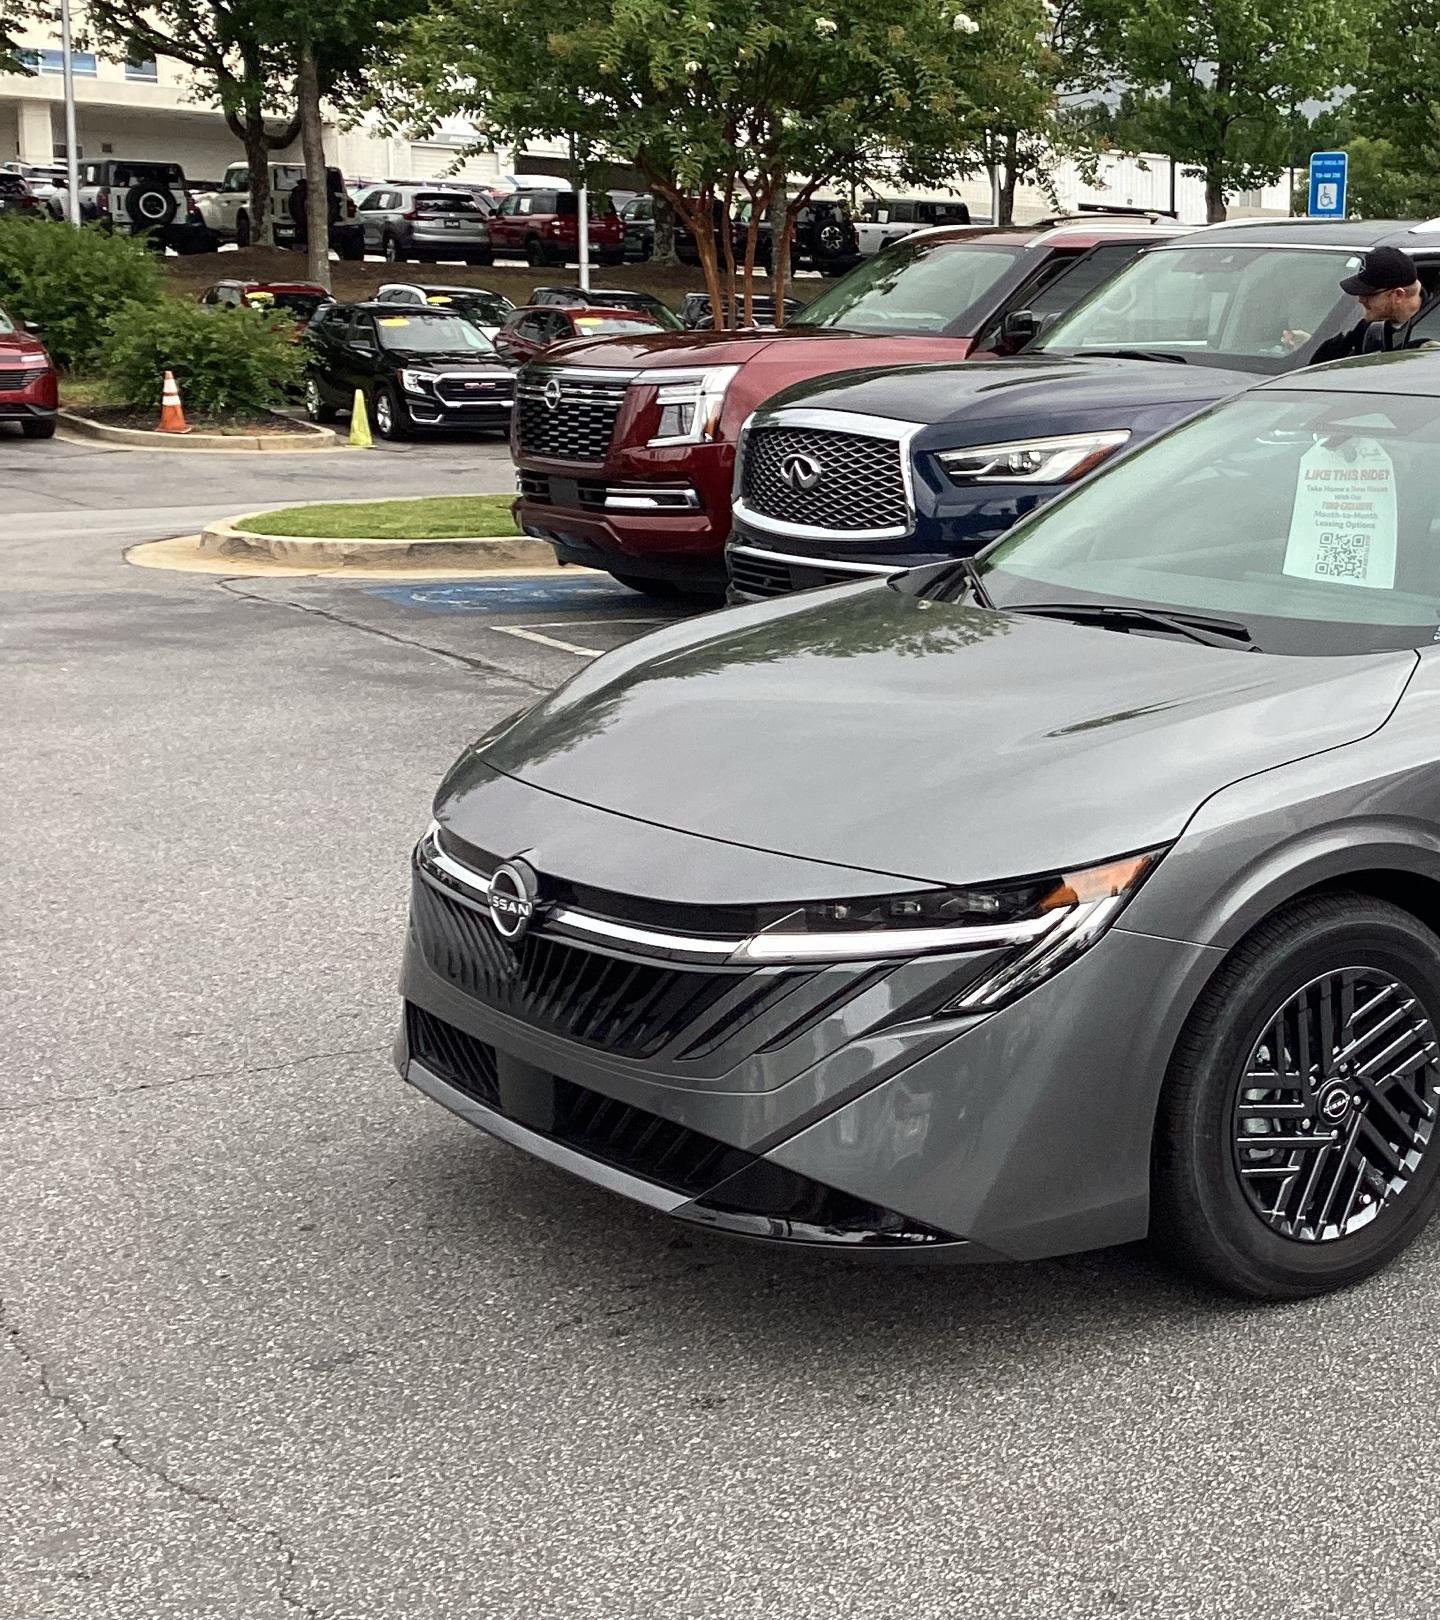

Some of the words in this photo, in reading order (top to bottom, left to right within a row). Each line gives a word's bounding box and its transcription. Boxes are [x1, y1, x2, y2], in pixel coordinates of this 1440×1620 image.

[1304, 469, 1332, 481] LIKE
[1332, 469, 1360, 481] THIS
[1360, 469, 1390, 481] RIDE?
[1315, 519, 1344, 529] Leasing
[1345, 521, 1376, 530] Options
[491, 895, 530, 916] SSAN
